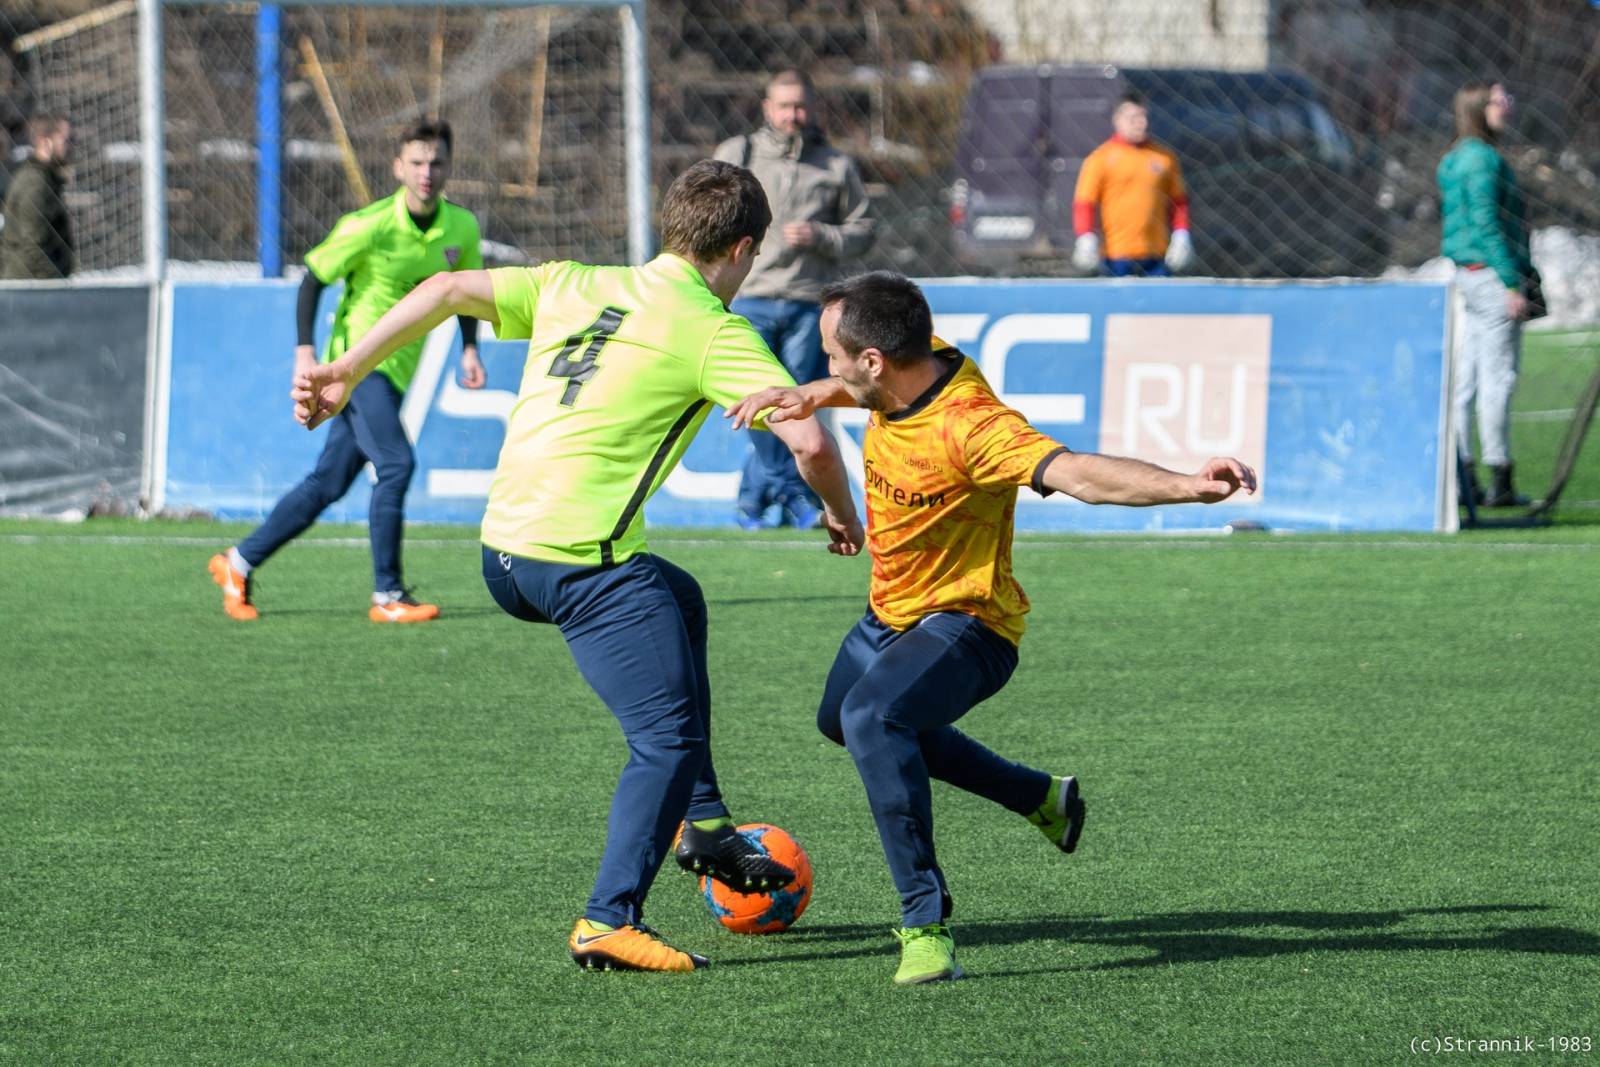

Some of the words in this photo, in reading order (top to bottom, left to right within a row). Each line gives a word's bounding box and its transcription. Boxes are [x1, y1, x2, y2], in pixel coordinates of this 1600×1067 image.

[547, 306, 630, 406] 4
[1122, 362, 1249, 455] RU
[902, 453, 943, 473] lubiteli.ru
